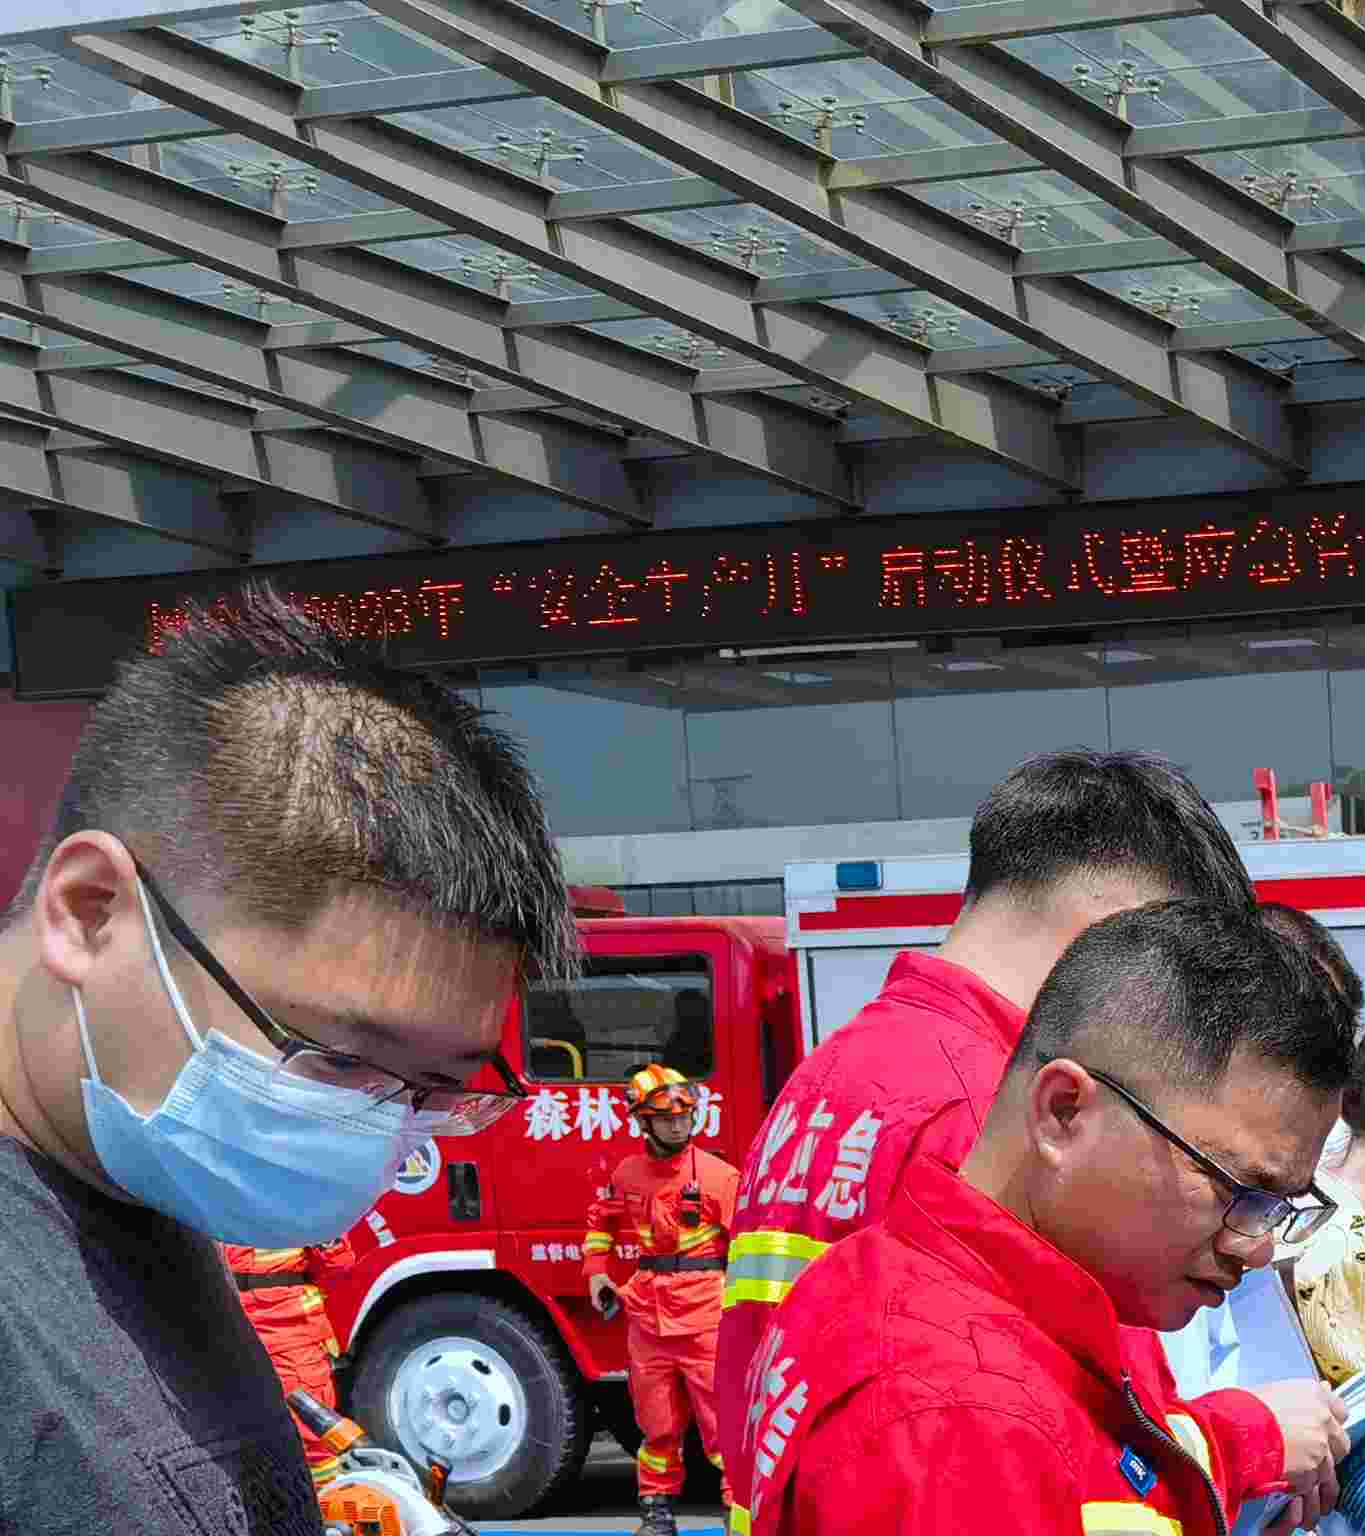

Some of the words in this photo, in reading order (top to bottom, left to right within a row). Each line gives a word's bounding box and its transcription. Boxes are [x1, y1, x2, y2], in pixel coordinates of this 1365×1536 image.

[524, 1086, 723, 1141] 森林防
[531, 1242, 588, 1263] 监督电
